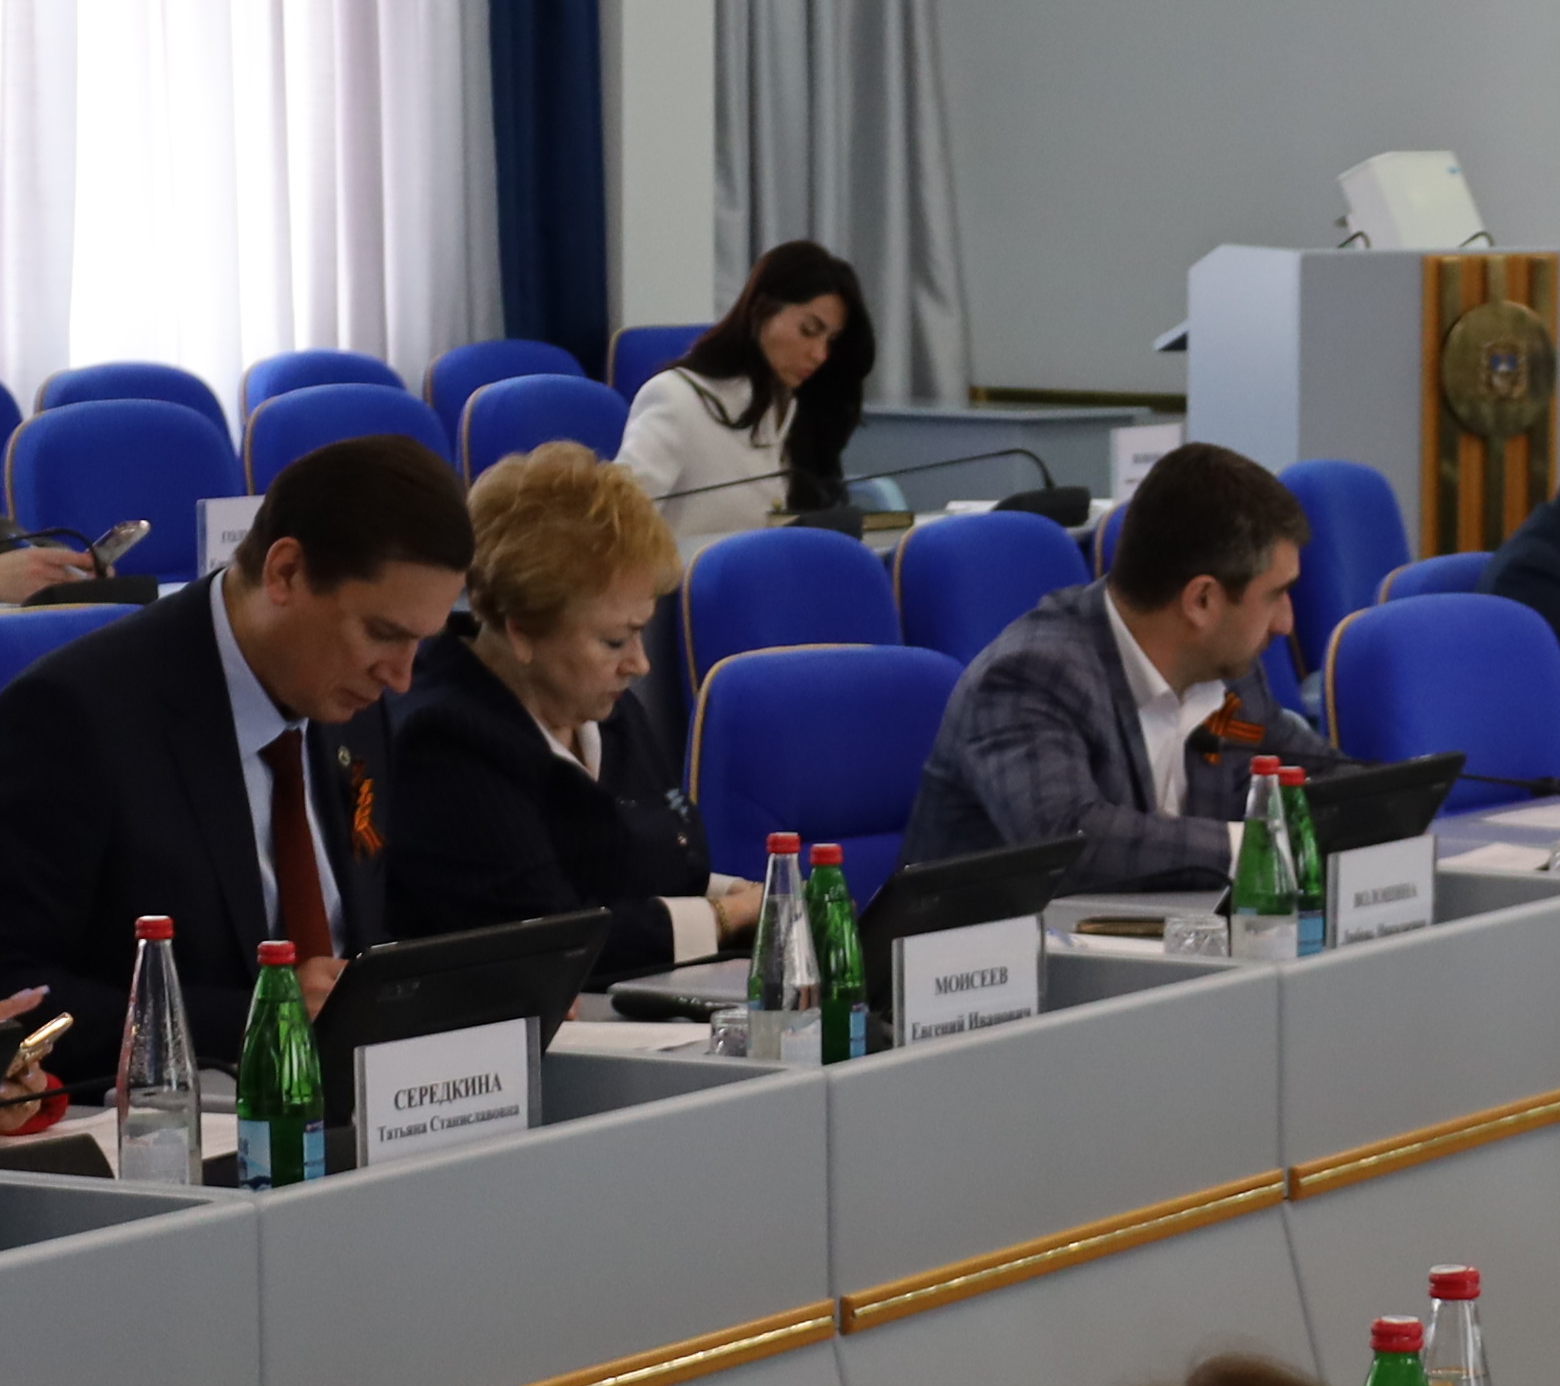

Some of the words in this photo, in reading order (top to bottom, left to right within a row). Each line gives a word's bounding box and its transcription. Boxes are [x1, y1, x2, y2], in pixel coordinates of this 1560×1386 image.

[934, 966, 1008, 995] МОИСЕЕВ
[394, 1073, 502, 1111] СЕРЕДКИНА
[378, 1122, 428, 1142] Татьяна
